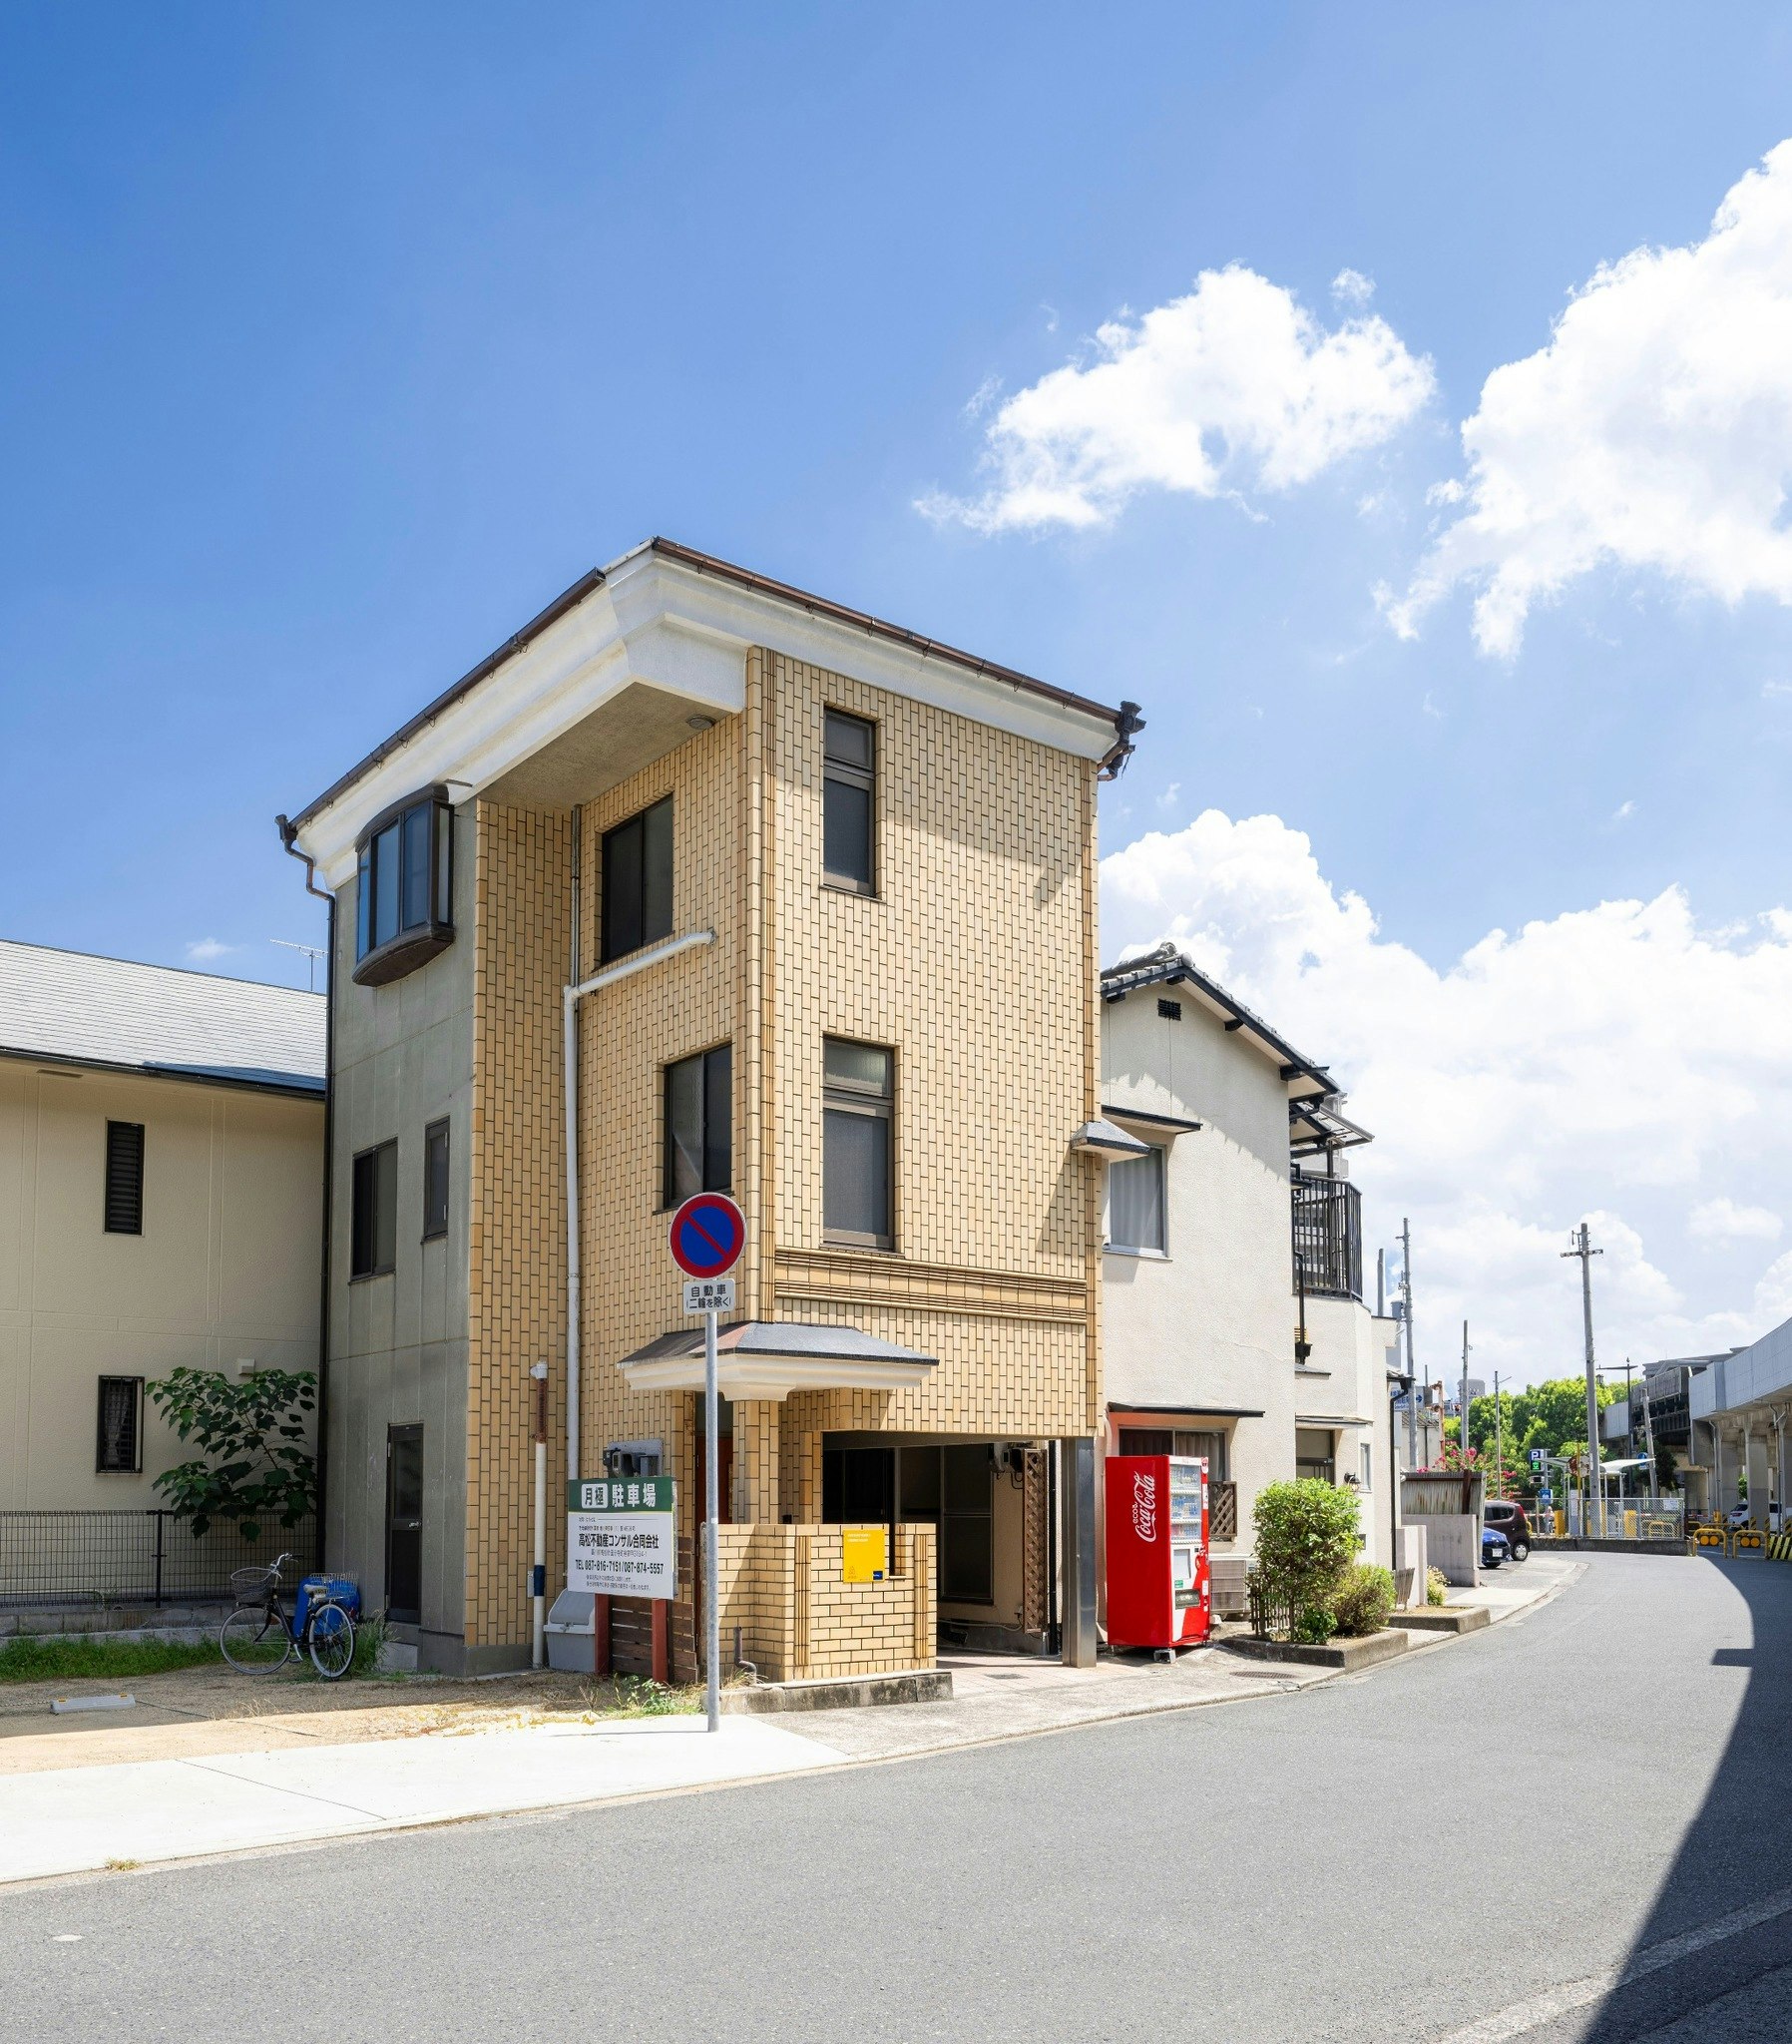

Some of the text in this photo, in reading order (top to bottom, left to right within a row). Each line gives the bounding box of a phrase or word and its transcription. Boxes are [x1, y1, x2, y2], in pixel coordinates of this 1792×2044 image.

[691, 1284, 726, 1297] 自動車
[1531, 1451, 1539, 1460] P
[612, 1483, 656, 1507] 駐車場
[579, 1533, 659, 1549] 高松不動産コンサル合同会社
